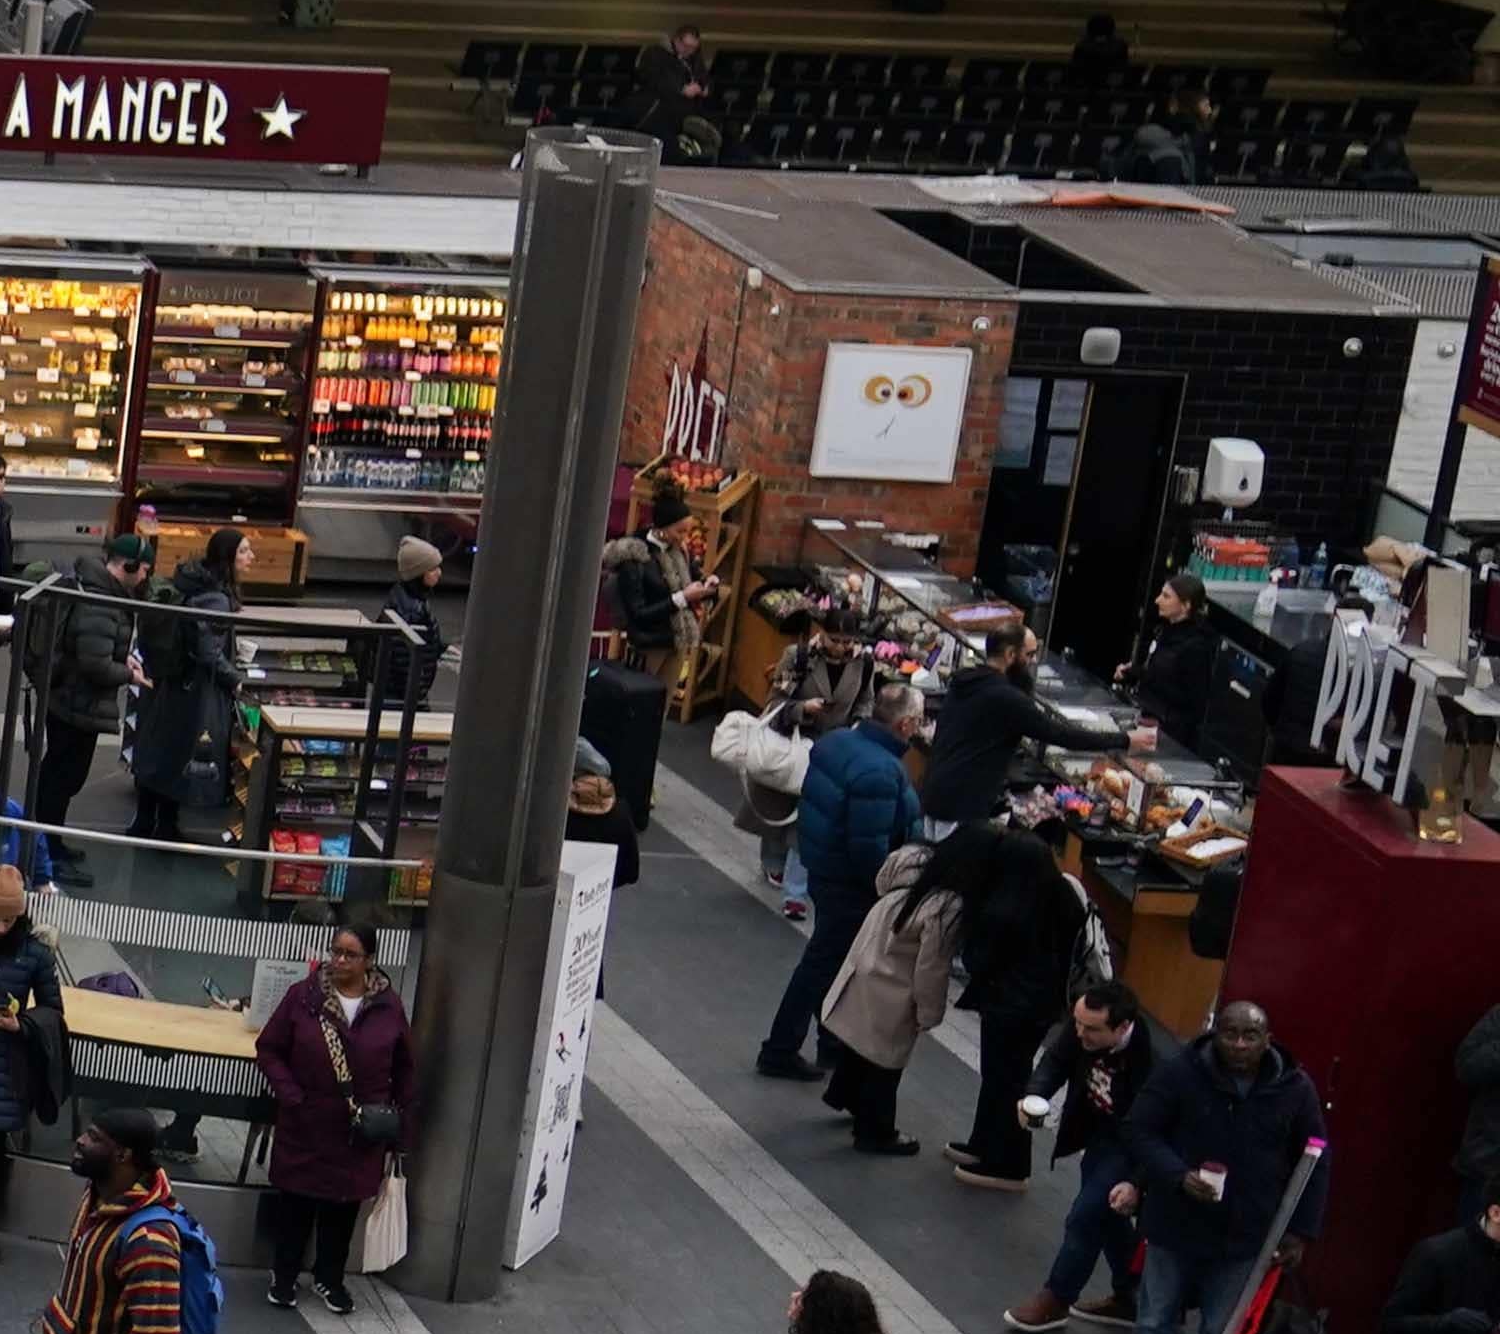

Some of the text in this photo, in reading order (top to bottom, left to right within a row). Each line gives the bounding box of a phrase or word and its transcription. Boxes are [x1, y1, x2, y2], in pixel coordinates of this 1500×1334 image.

[3, 73, 31, 139] A
[51, 73, 229, 146] MANGER
[662, 362, 726, 464] PRET
[1309, 614, 1437, 805] PRET
